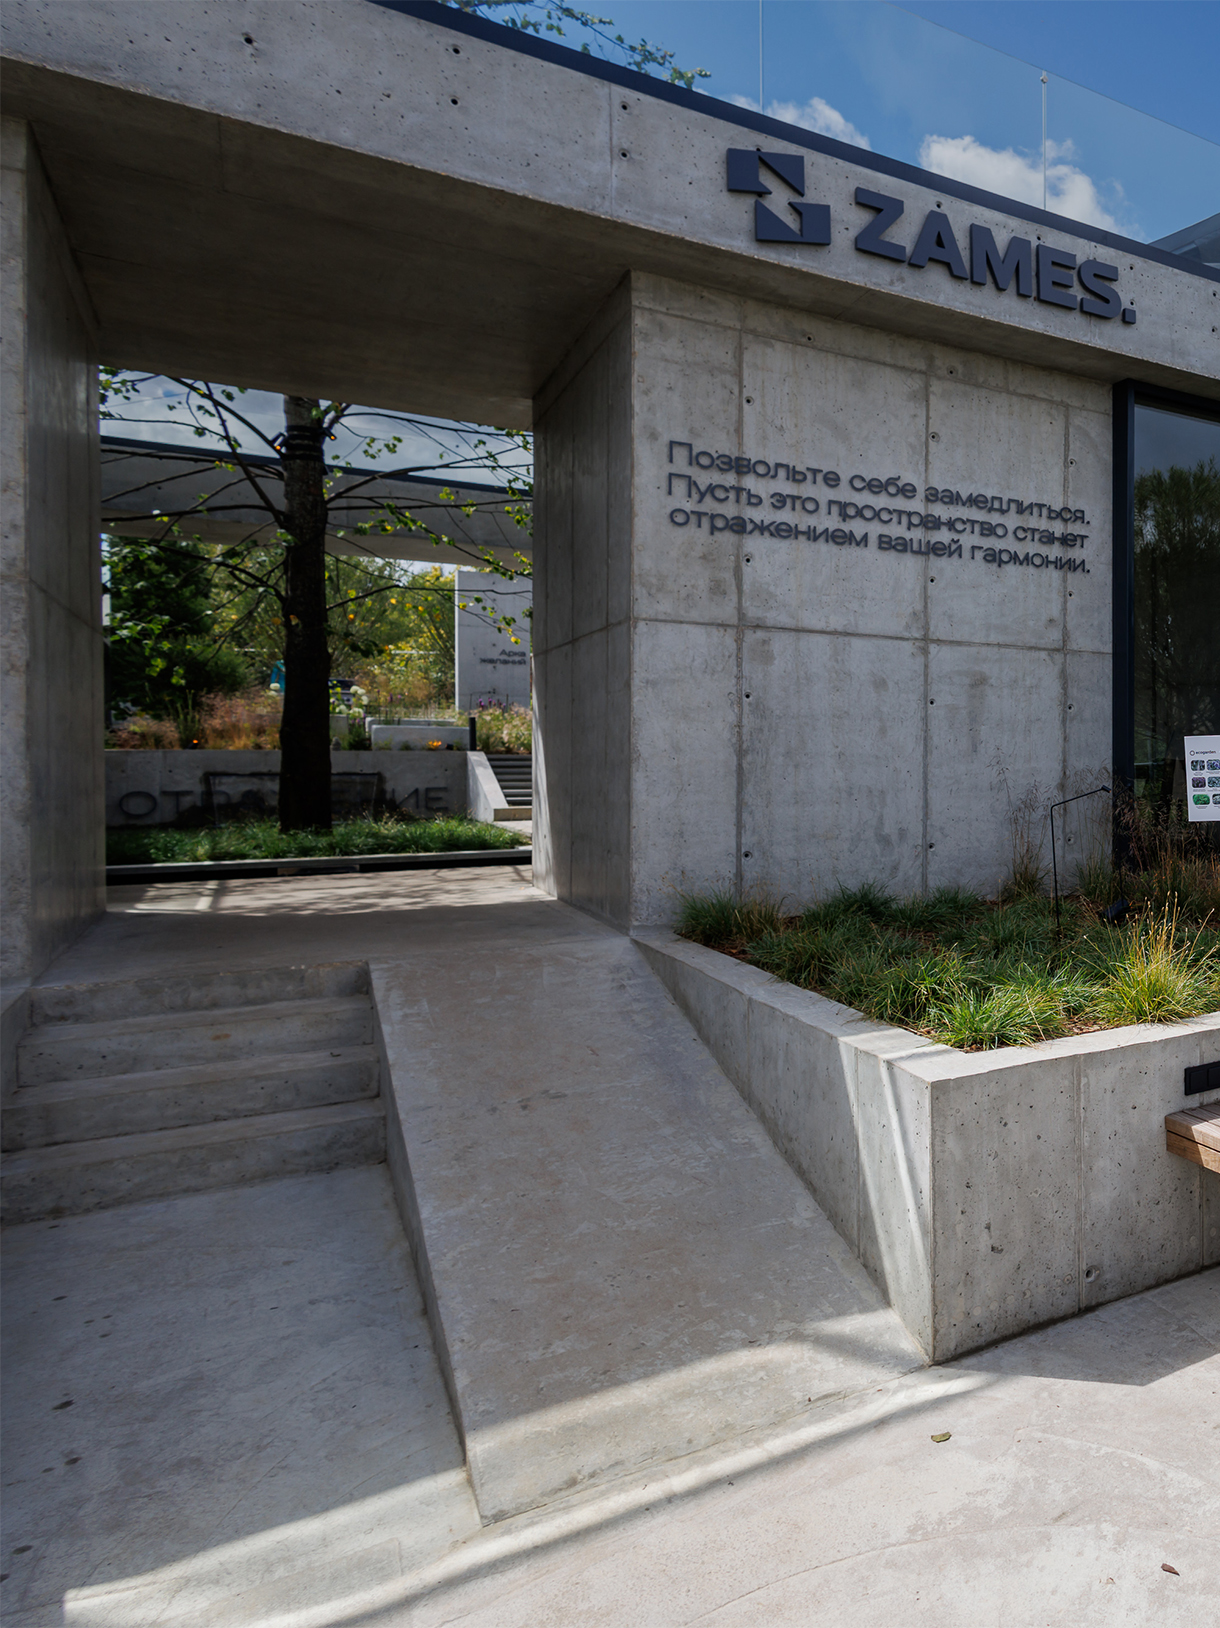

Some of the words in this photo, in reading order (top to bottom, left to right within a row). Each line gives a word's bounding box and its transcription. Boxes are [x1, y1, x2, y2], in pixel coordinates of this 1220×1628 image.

[854, 186, 1137, 325] ZAMES.
[668, 440, 841, 488] Позвольте
[849, 474, 917, 499] себе
[926, 485, 1091, 526] замедлиться.
[668, 473, 763, 508] Пусть
[770, 491, 820, 514] это
[828, 500, 1008, 540] пространство
[1013, 523, 1089, 550] станет
[669, 508, 868, 549] отражением
[878, 533, 962, 560] вашей
[971, 545, 1091, 574] гармонии.
[480, 657, 526, 665] желаний
[499, 649, 526, 657] Арка
